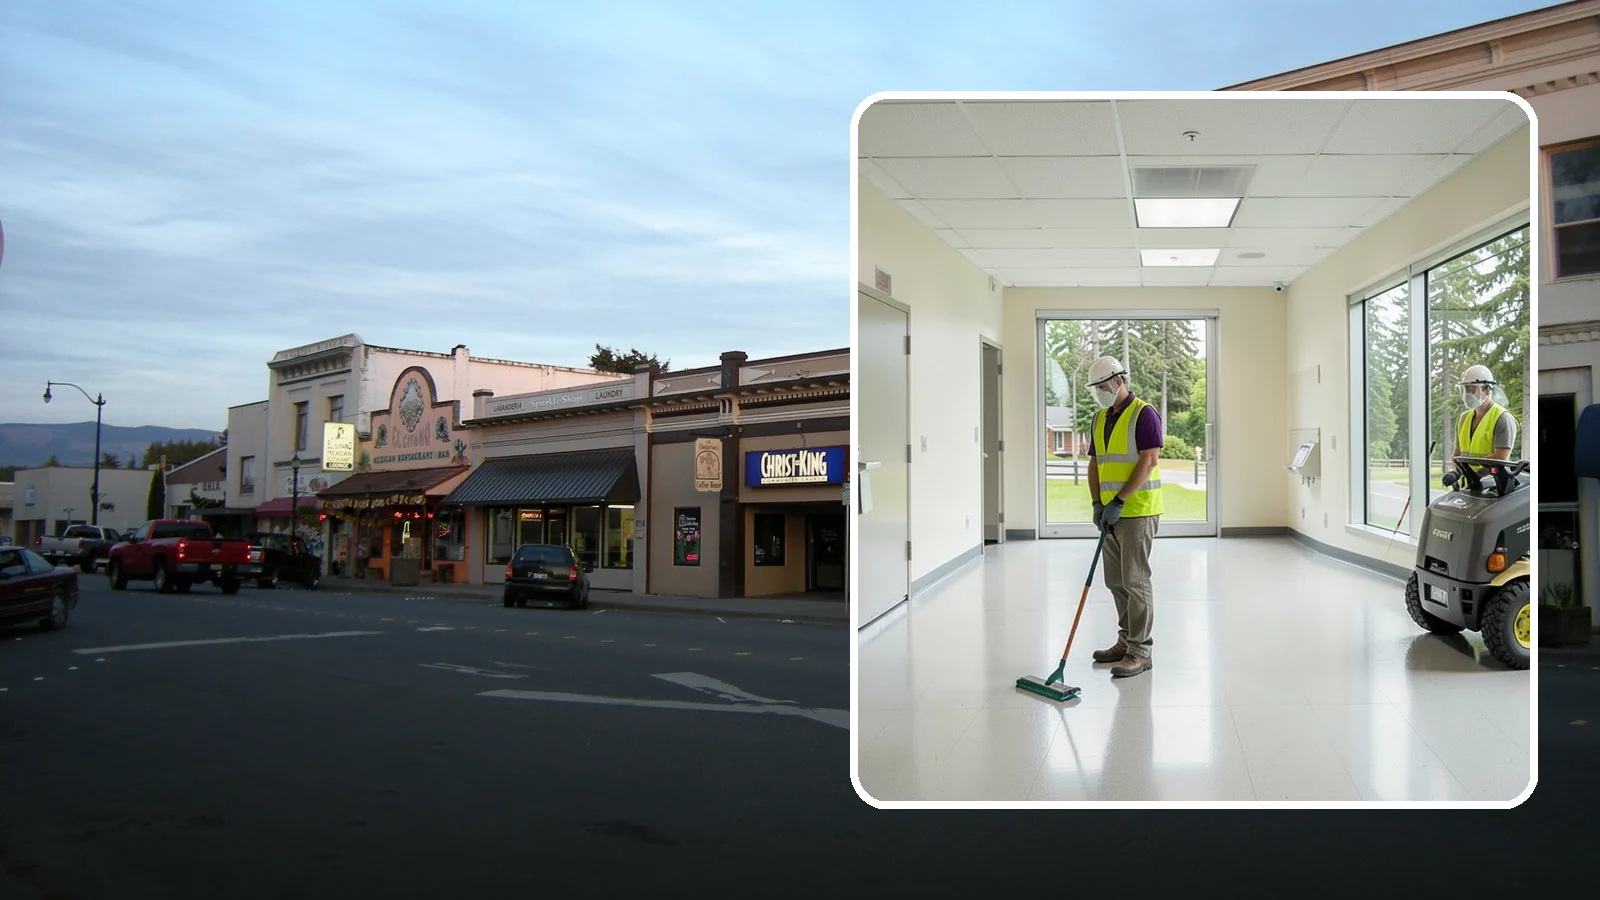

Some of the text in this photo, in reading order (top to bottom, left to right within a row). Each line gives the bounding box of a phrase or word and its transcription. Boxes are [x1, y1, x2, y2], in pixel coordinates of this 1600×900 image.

[493, 402, 522, 412] LAVANDERIA
[595, 389, 623, 400] LAUNDRY
[373, 450, 450, 464] MEXICAN RESTAURANT BAR
[761, 450, 827, 478] CHRIST KING
